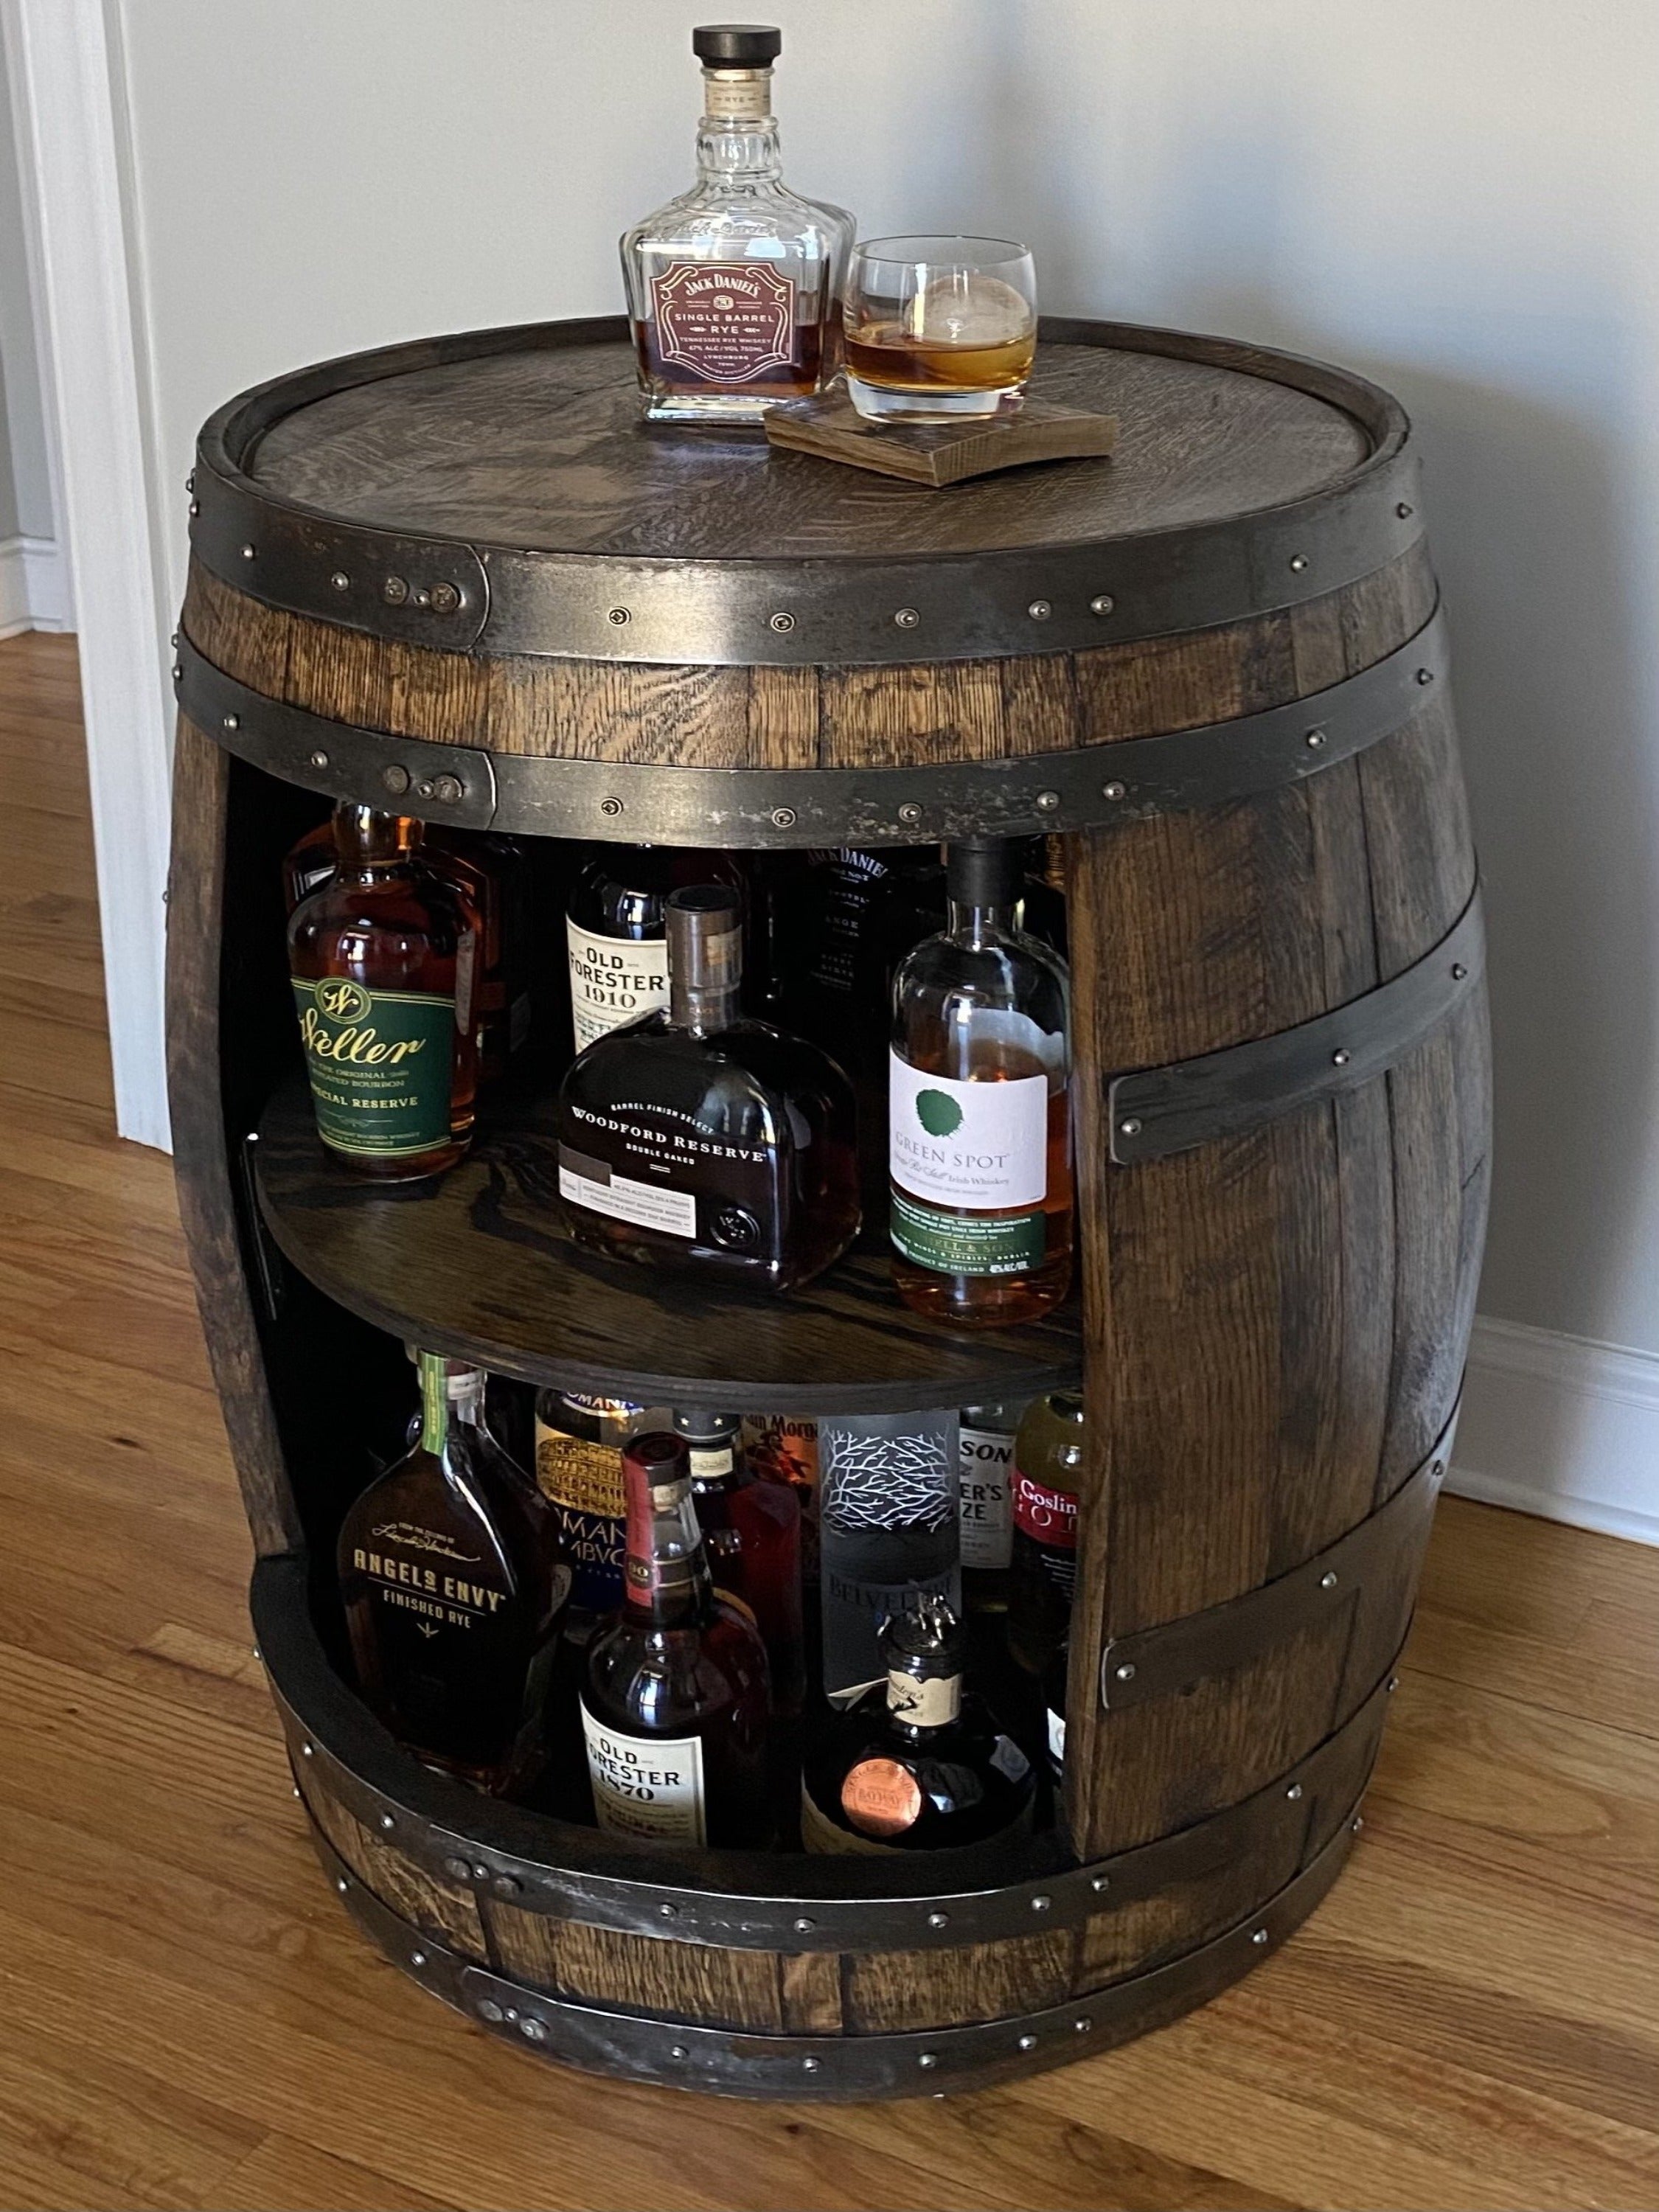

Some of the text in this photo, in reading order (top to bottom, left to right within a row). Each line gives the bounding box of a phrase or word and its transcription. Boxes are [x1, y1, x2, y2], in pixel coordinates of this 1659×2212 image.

[684, 274, 762, 298] JACK DANIEL'S
[675, 313, 775, 323] SINGLE BARREL
[711, 326, 739, 334] RYE
[571, 953, 664, 990] FORESTER
[587, 947, 623, 969] OLD
[585, 985, 636, 1009] 1910
[299, 1007, 426, 1064] Weller
[352, 1096, 419, 1109] RESERVE
[611, 1103, 714, 1134] BARREL FINISH SELECT
[571, 1106, 764, 1163] WOODFORD RESERVE
[626, 1143, 695, 1164] DOUBLE OAKED
[895, 1130, 945, 1164] GREEN
[953, 1153, 1006, 1169] SPOT
[445, 1576, 498, 1613] ENVY
[383, 1590, 470, 1628] FINISHED RYE
[589, 1742, 680, 1786] ORESTER
[599, 1738, 637, 1764] OLD
